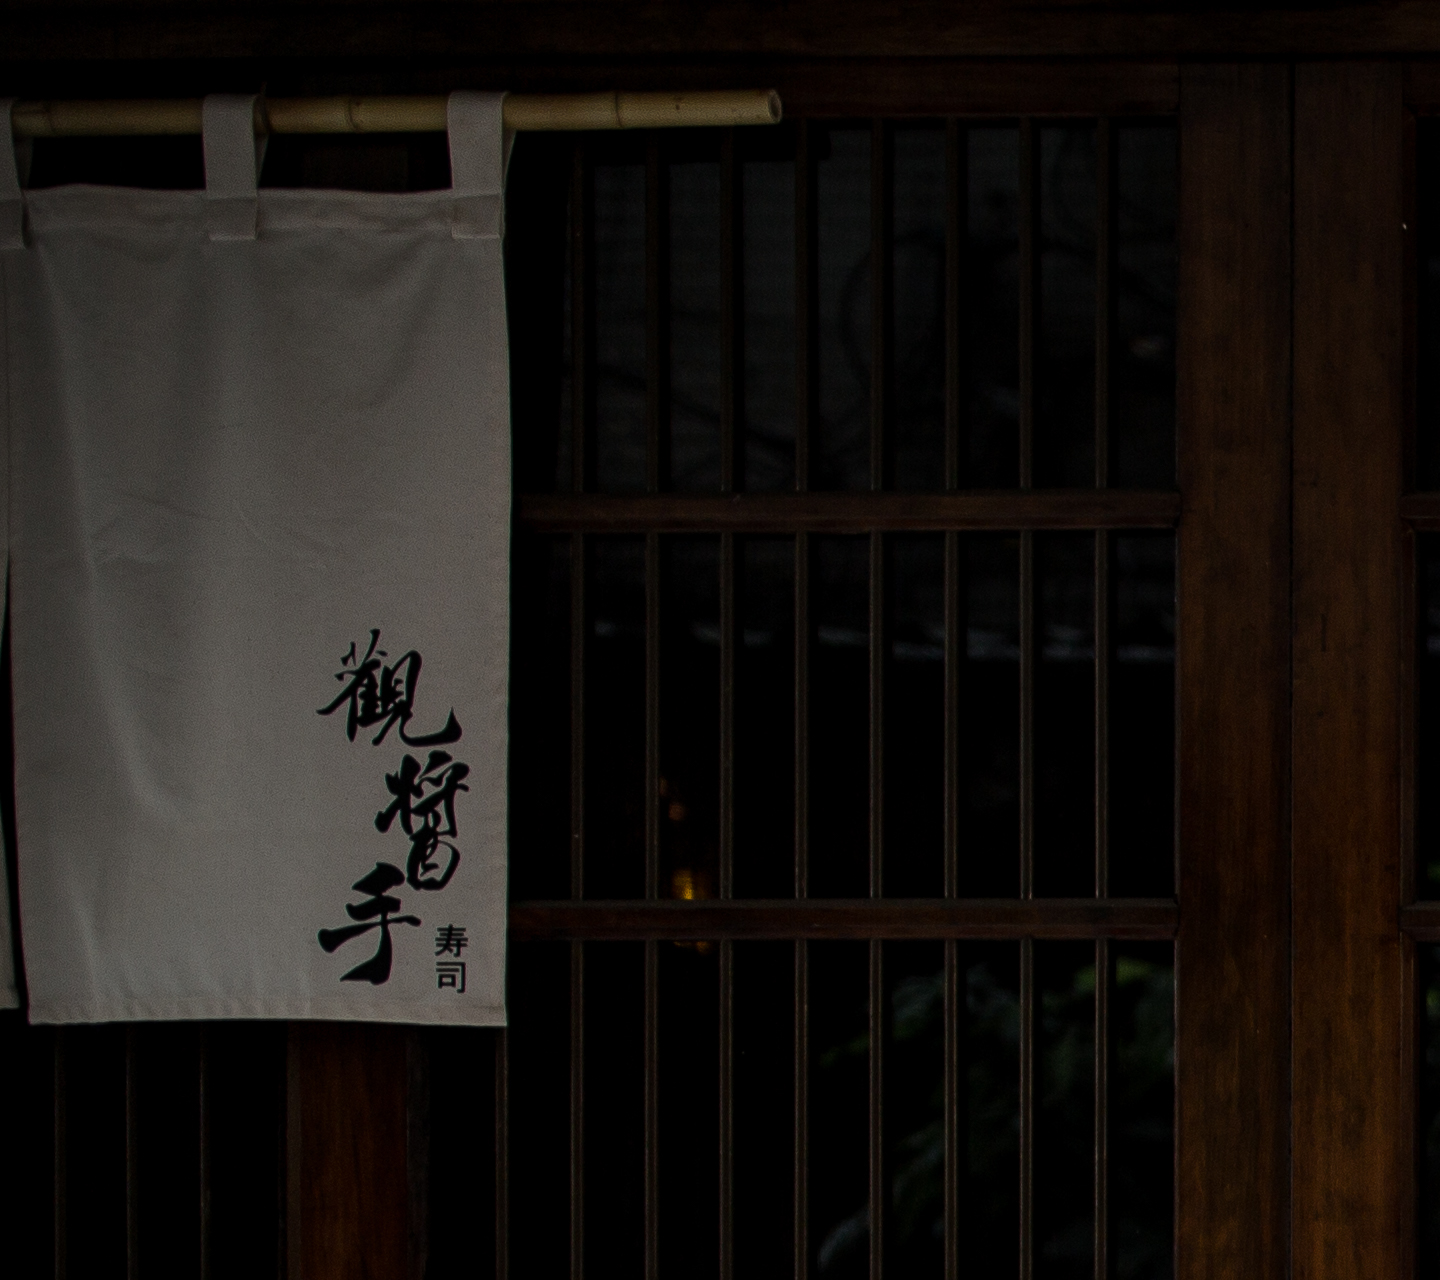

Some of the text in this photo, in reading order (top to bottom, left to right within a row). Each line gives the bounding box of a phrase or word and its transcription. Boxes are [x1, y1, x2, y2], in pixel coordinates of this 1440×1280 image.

[316, 629, 470, 985] 觀醬手
[434, 923, 469, 994] 寿司
